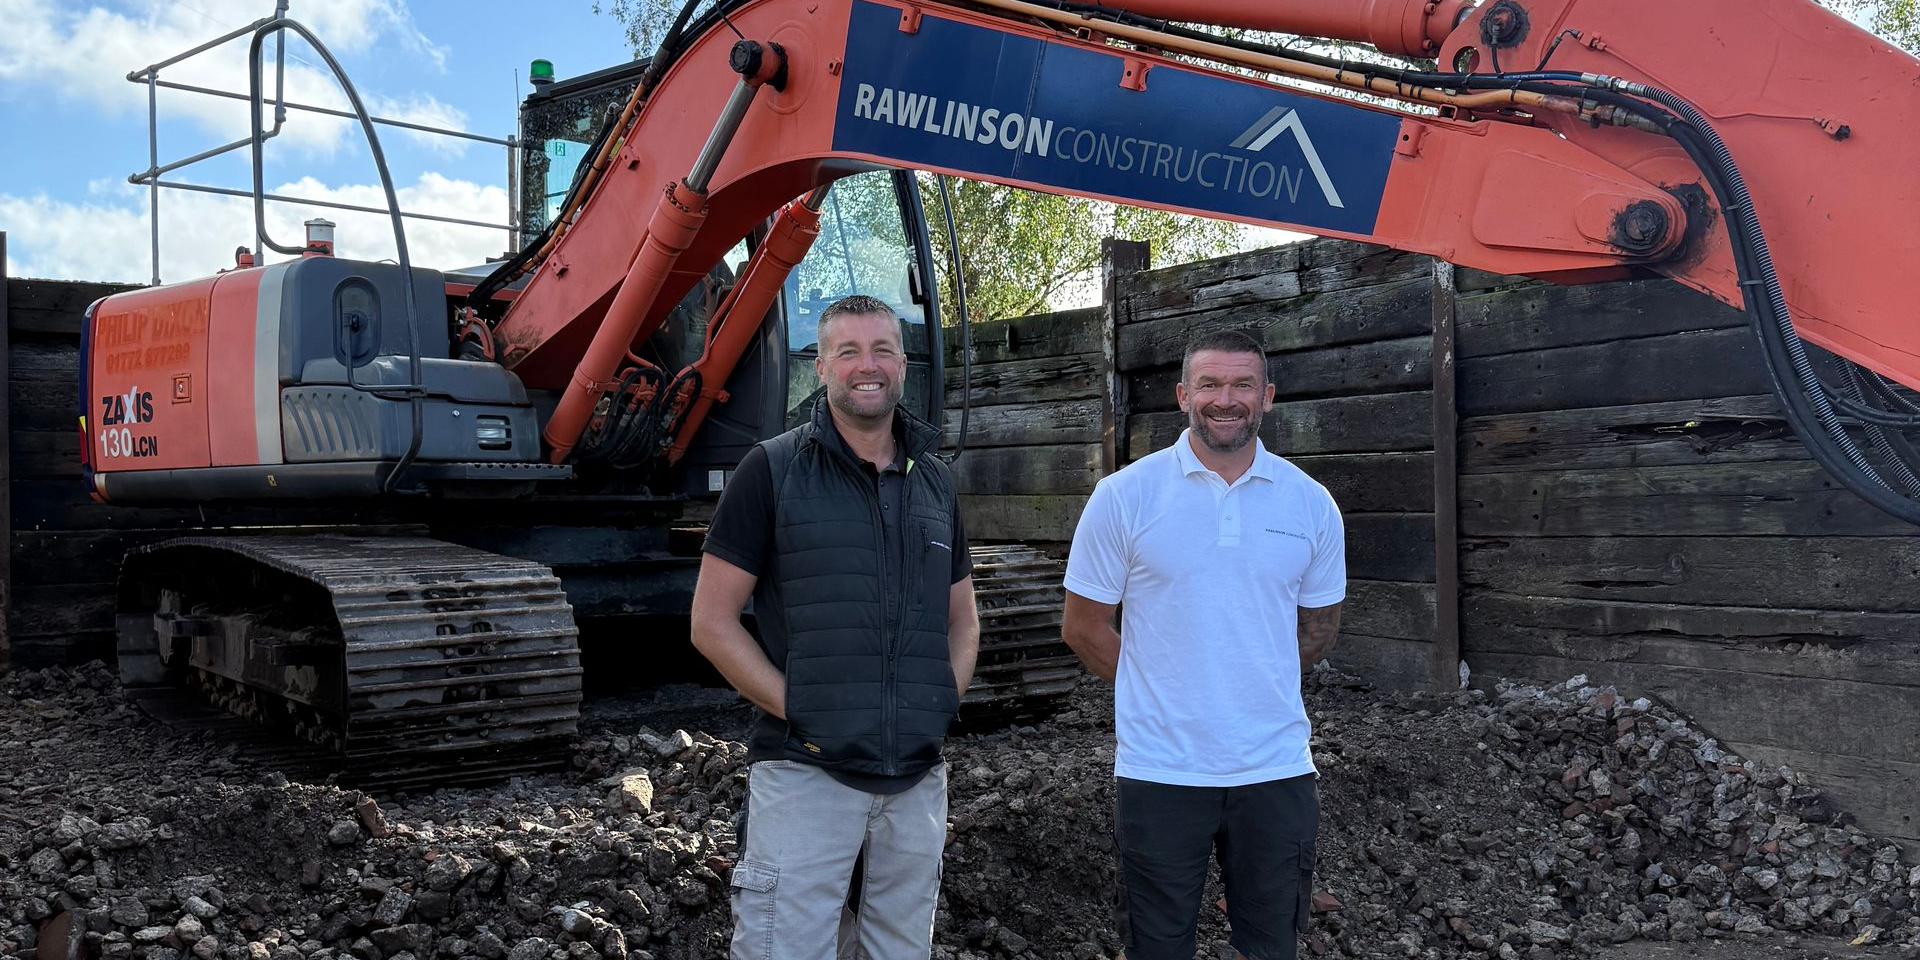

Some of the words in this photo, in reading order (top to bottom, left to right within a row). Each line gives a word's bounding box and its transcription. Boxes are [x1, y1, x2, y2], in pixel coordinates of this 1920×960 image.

[854, 83, 1054, 157] RAWLINSON
[1055, 125, 1304, 204] CONSTRUCTION
[95, 311, 148, 348] PHILIP
[152, 298, 207, 341] DIXON
[106, 350, 142, 374] 01772
[102, 385, 154, 426] ZAXIS
